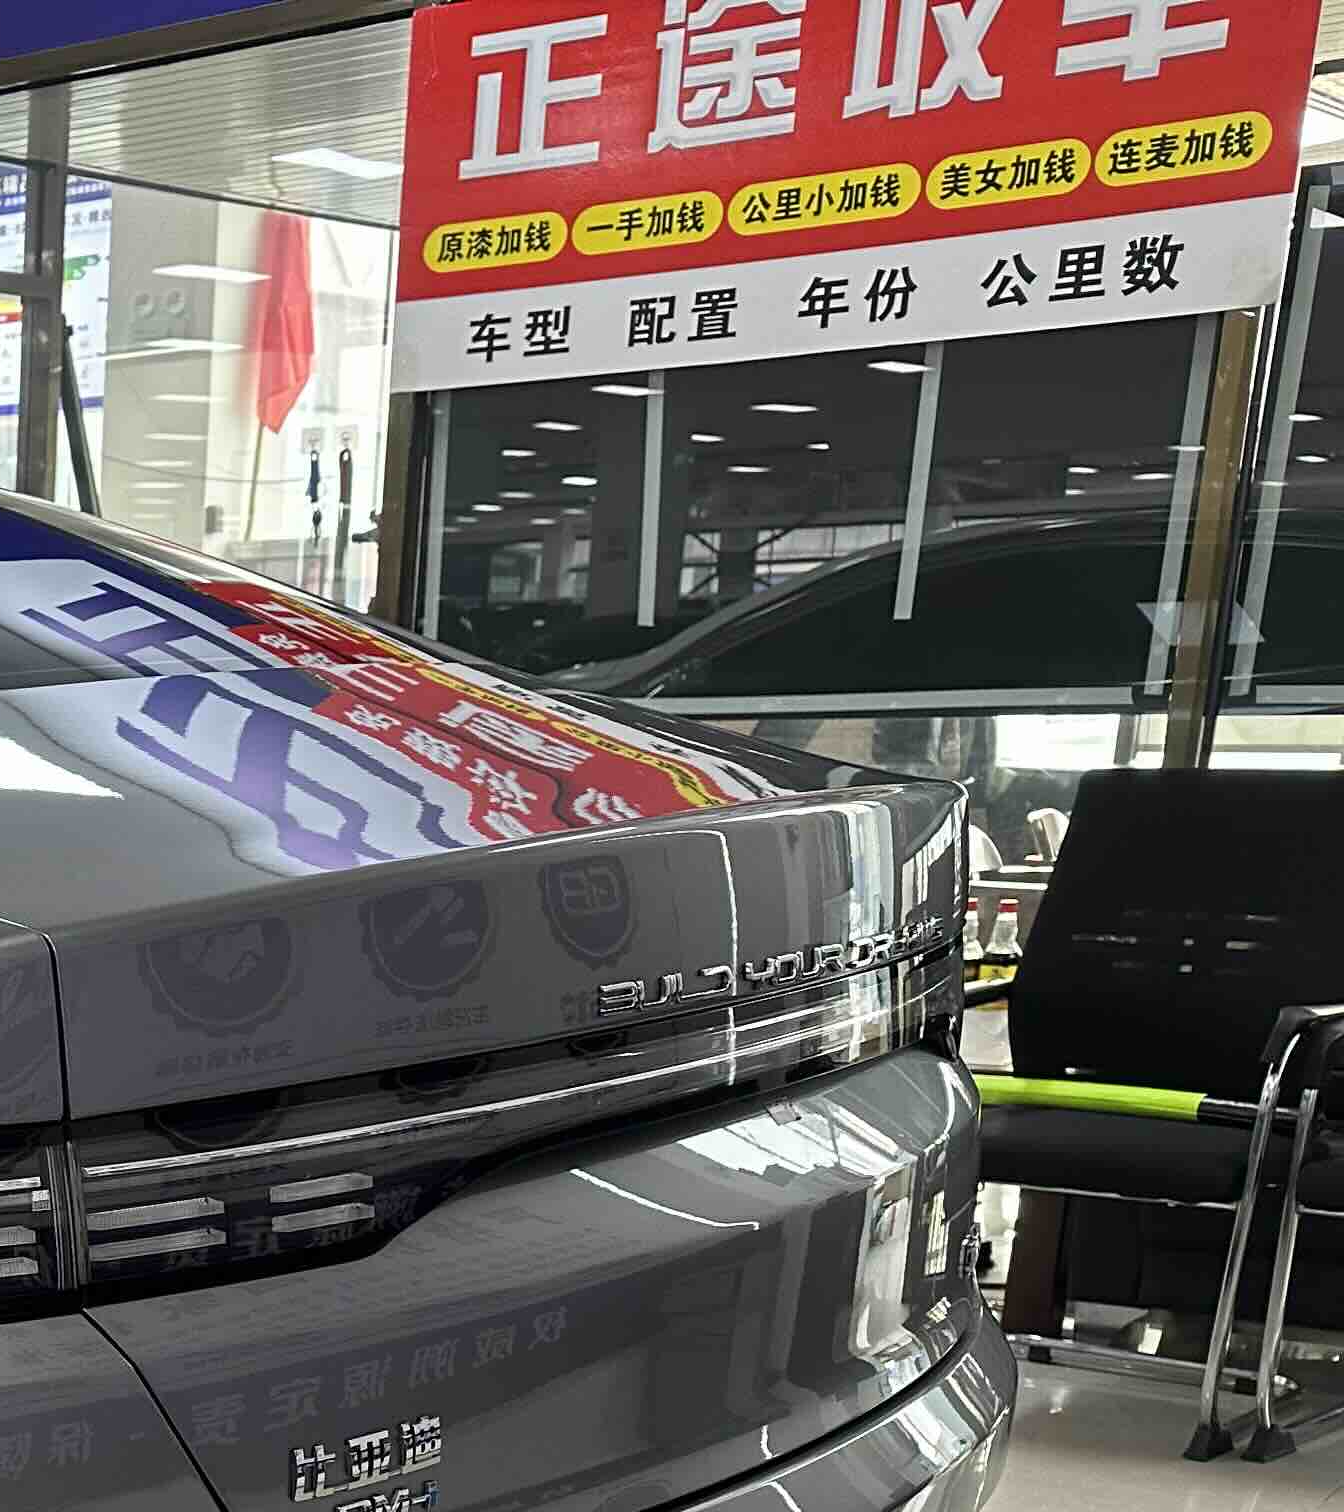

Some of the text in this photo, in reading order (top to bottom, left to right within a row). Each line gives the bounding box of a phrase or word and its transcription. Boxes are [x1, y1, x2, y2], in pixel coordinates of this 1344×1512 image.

[437, 121, 1255, 263] 原漆加钱 一手加钱 公里小加钱 美女加钱 连麦加钱
[466, 233, 1185, 363] 车型 配置 年份 公里数
[598, 966, 738, 1017] BUILD
[744, 942, 846, 989] YOUR
[289, 1415, 442, 1503] 比亚迪
